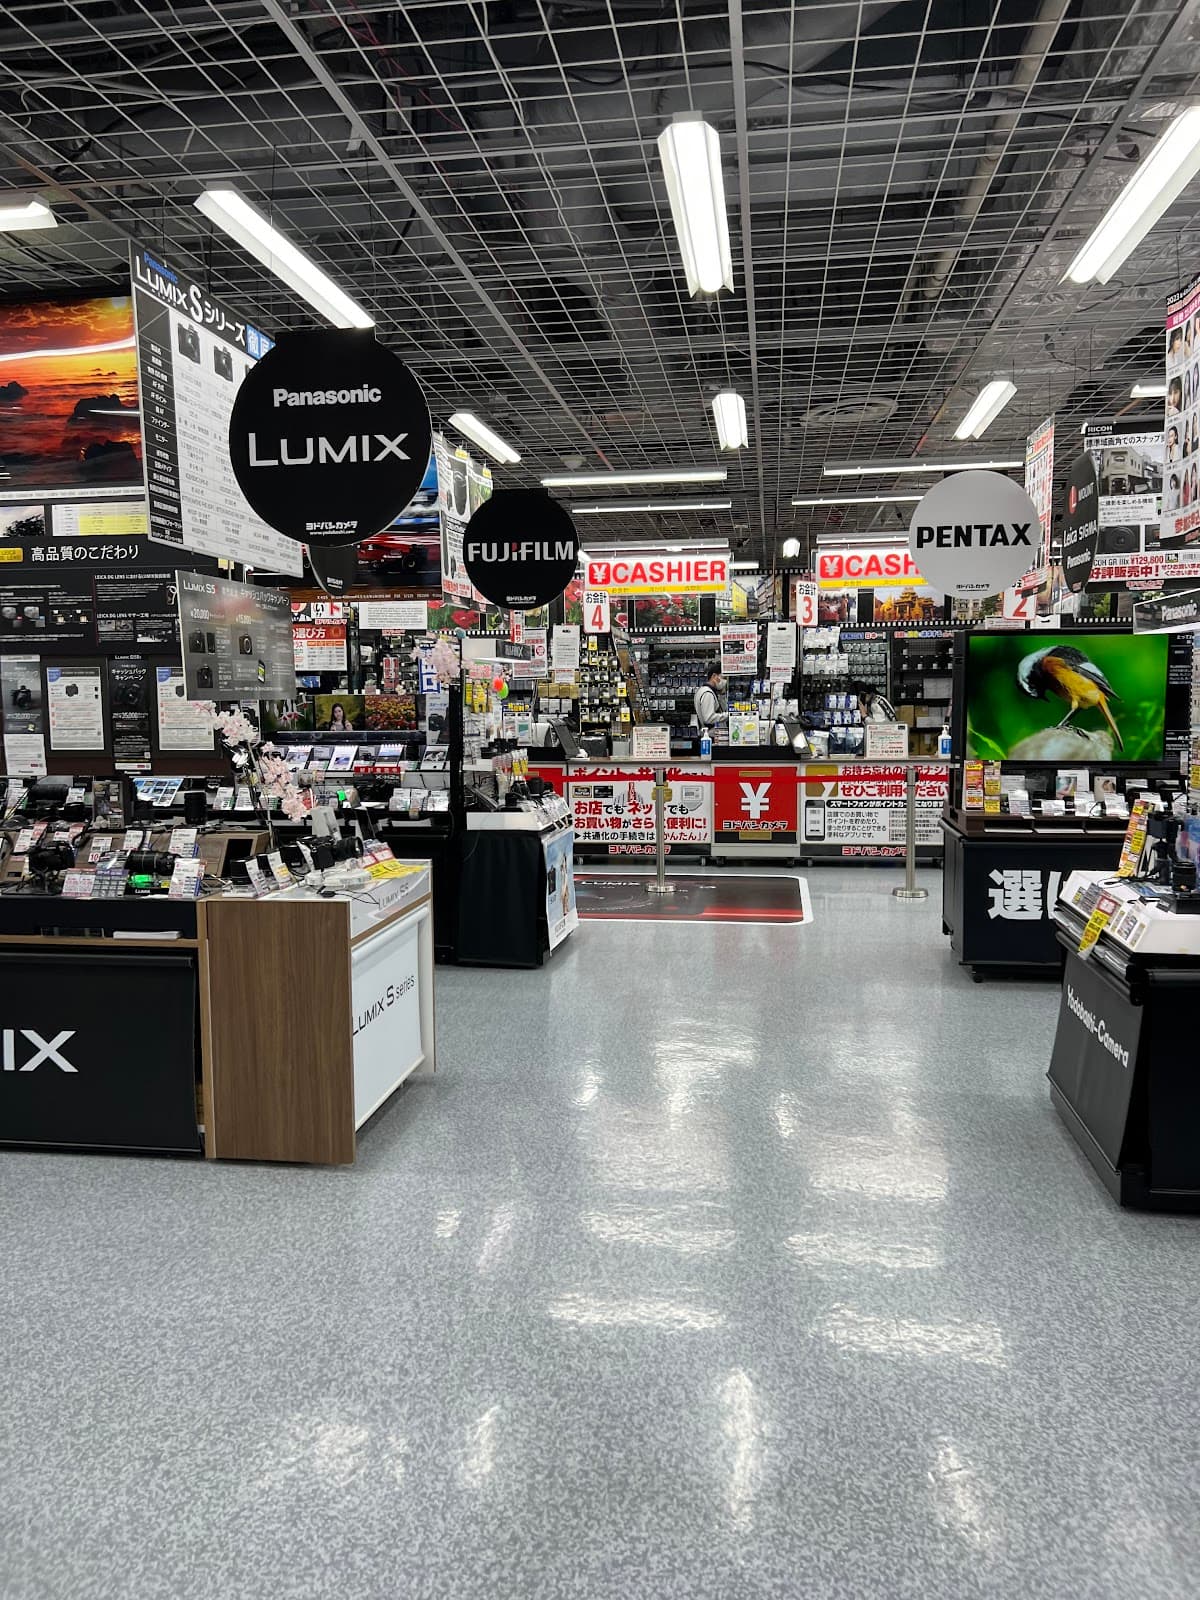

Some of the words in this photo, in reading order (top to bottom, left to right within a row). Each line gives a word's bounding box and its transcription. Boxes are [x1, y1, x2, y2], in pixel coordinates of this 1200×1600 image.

[143, 251, 178, 284] Panasonic
[135, 255, 190, 311] LUMIX
[189, 284, 204, 324] S
[204, 300, 246, 348] シリーズ
[272, 383, 382, 408] Panasonic
[1087, 424, 1113, 433] RICOH
[248, 432, 411, 467] LUMIX
[1086, 434, 1164, 450] 標準域画角でのスナップ
[916, 523, 1032, 549] PENTAX
[1063, 526, 1078, 548] Leica
[1078, 519, 1097, 541] SIGMA
[31, 545, 139, 562] 高品質のこだわり
[467, 540, 574, 562] FUJIFILM
[1066, 548, 1092, 570] Panasonic
[612, 560, 726, 584] CASHIER
[591, 604, 604, 630] 4
[802, 595, 814, 624] 3
[1161, 600, 1198, 621] Panasonic
[841, 784, 950, 798] ぜひご利用ださい
[574, 800, 690, 815] お店でもネッでも
[574, 816, 707, 830] お買い物がさら便利に！
[722, 820, 788, 831] ヨドバシカメラ
[386, 984, 395, 1007] S
[395, 975, 415, 999] series
